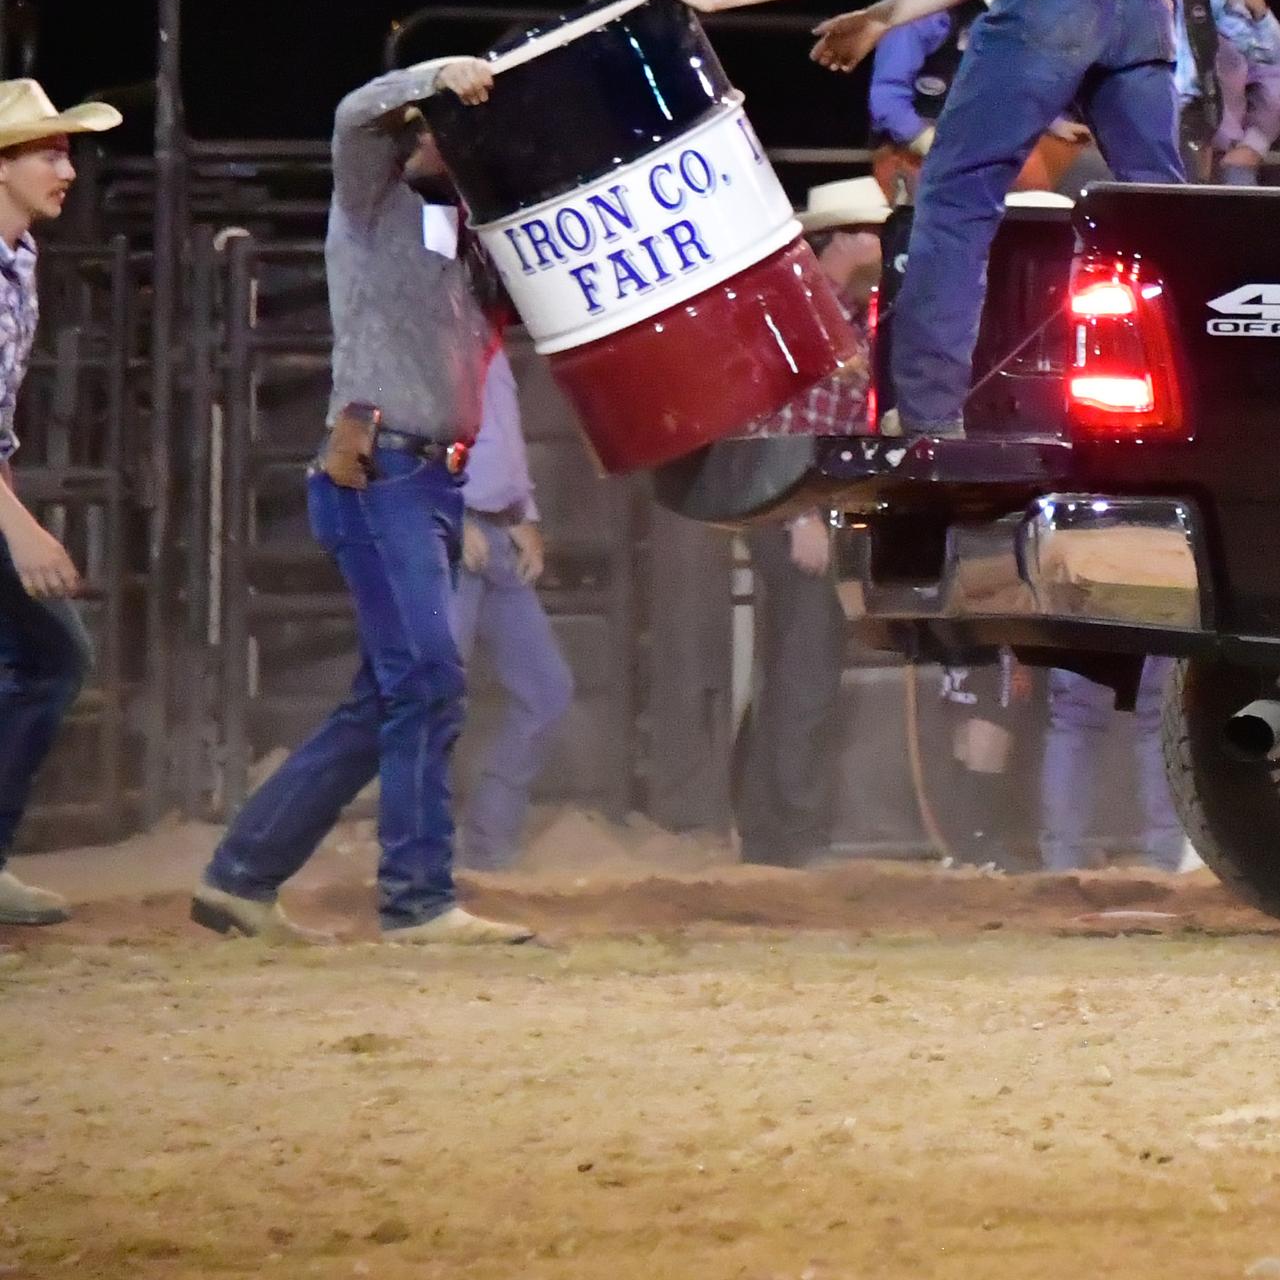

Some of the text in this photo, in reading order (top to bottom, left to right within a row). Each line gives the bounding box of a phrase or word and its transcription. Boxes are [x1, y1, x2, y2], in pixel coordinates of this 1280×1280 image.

[503, 148, 731, 276] IRON CO.
[569, 219, 715, 316] FAIR
